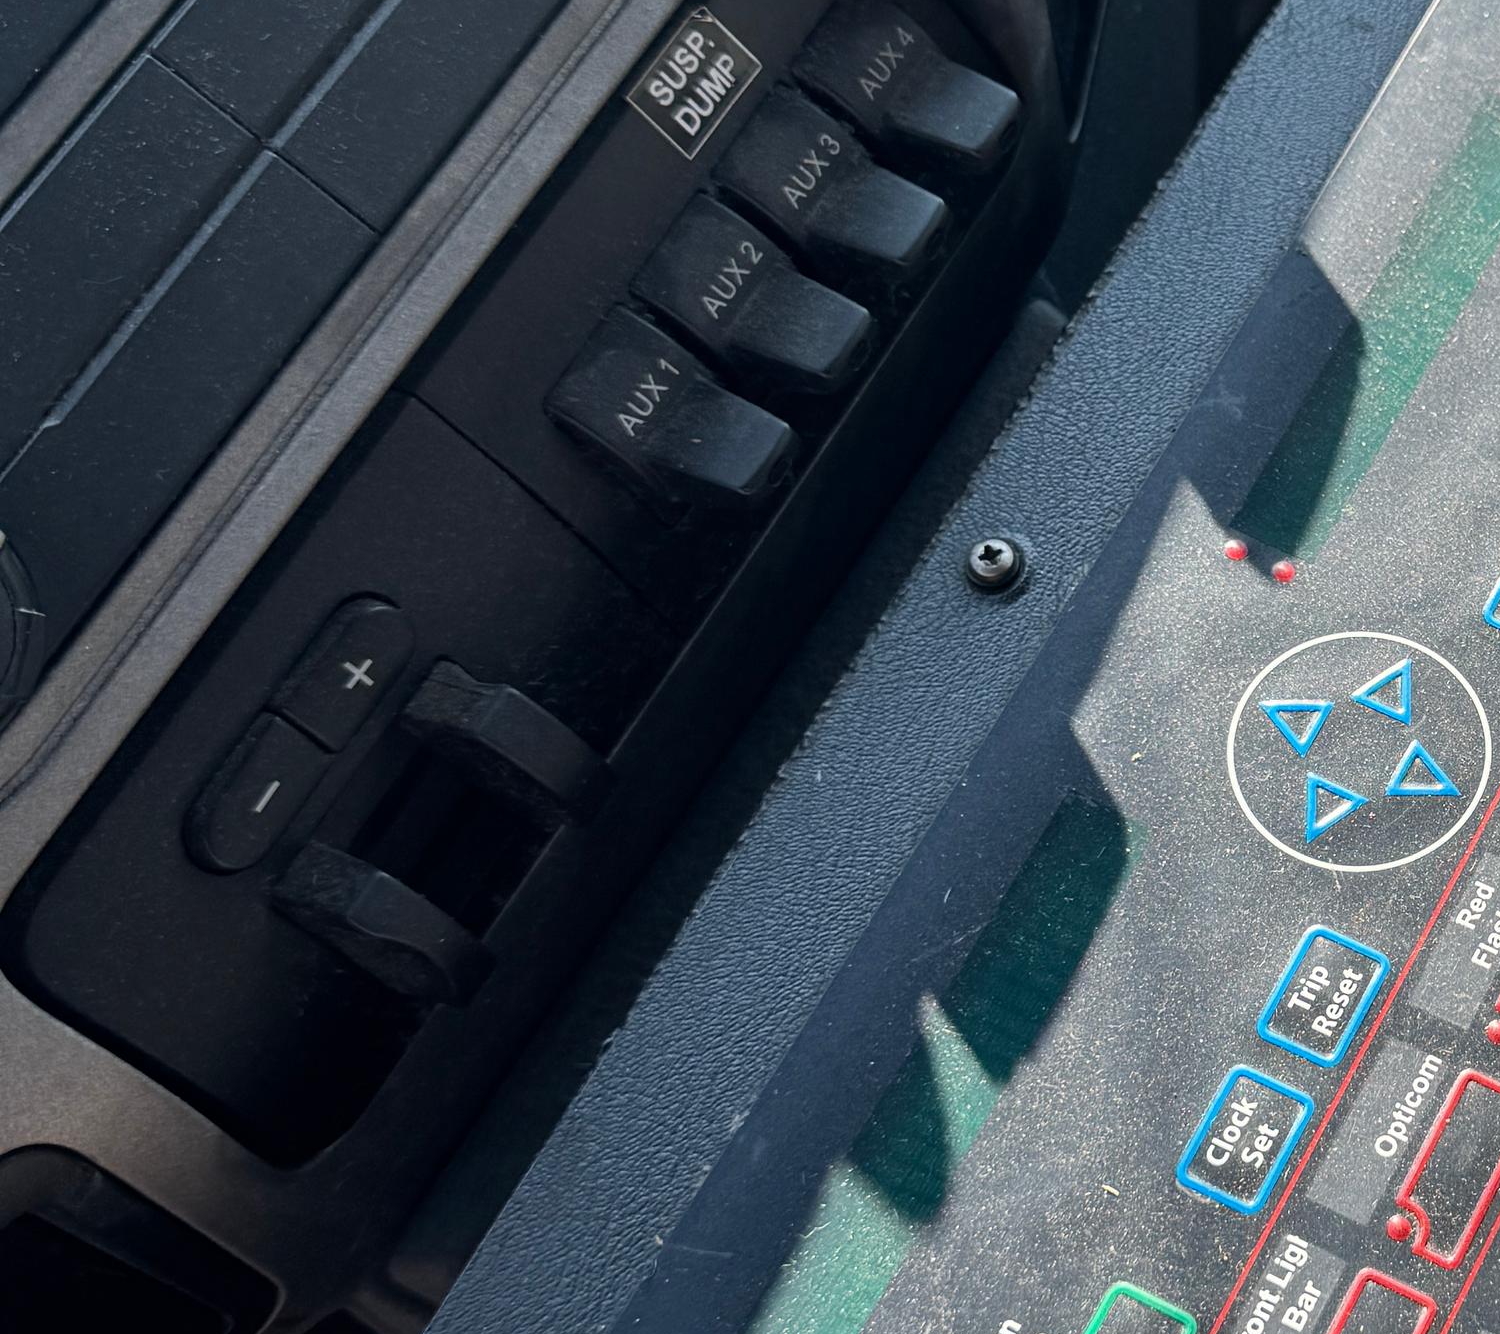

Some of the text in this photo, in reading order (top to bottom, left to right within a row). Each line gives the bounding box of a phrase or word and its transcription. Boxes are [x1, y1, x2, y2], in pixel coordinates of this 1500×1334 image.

[649, 31, 716, 106] SUSP.
[674, 52, 736, 135] DUMP
[858, 27, 915, 99] AUX 4
[783, 133, 841, 208] AUX 3
[702, 240, 763, 318] AUX 2
[618, 358, 680, 436] AUX 1
[1456, 881, 1495, 930] Red
[1288, 966, 1330, 1013] Trip
[1312, 967, 1364, 1038] Reset
[1206, 1096, 1258, 1167] Clock
[1375, 1054, 1443, 1158] Opticom
[1241, 1123, 1280, 1169] Set
[1282, 1279, 1322, 1333] Bar
